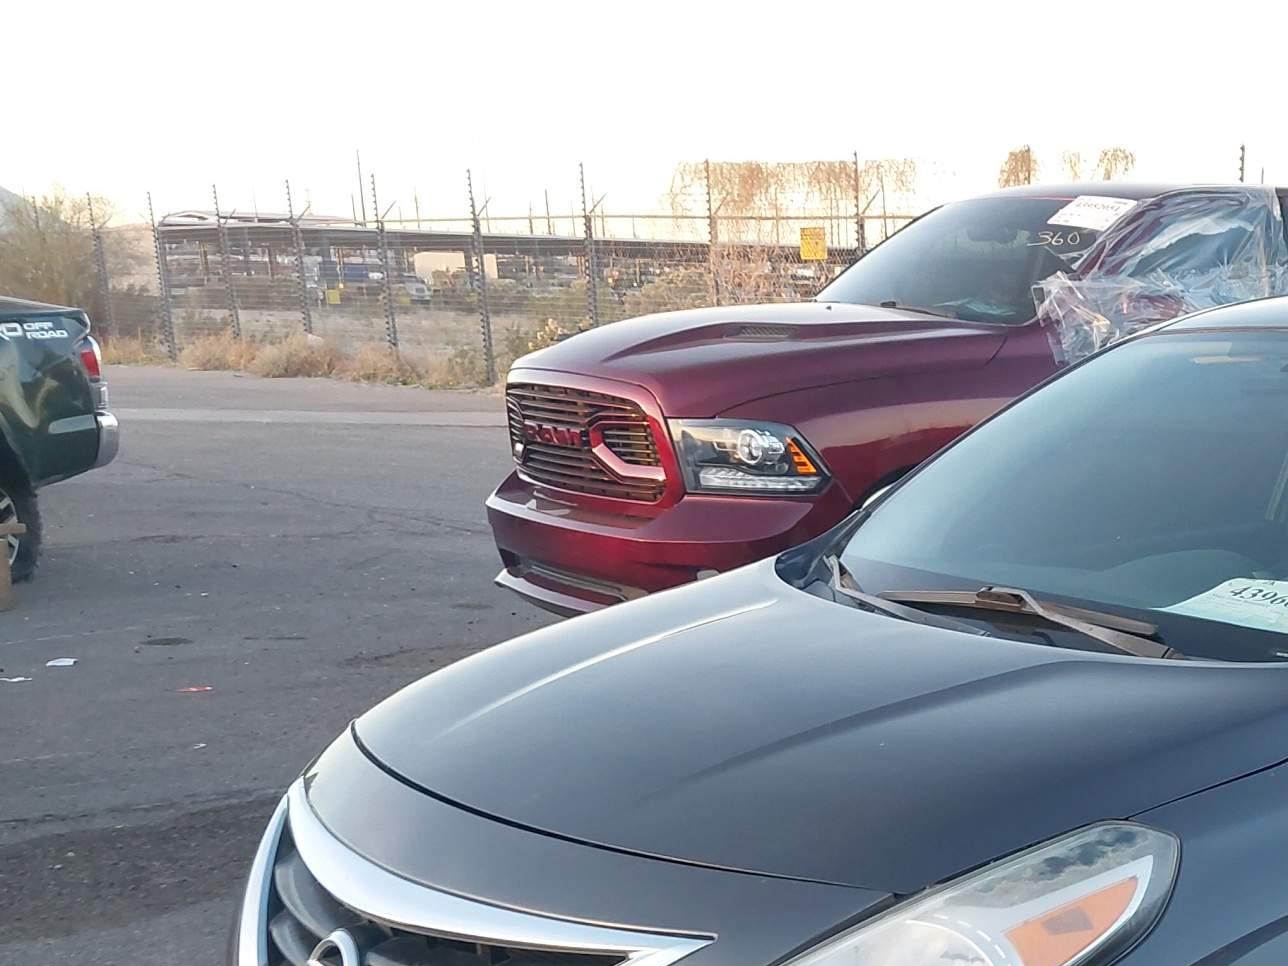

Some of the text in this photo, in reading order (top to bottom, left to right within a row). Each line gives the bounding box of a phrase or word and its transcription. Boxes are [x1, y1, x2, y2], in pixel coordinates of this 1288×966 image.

[1026, 230, 1080, 247] 360
[23, 321, 53, 330] OFF
[25, 329, 69, 340] ROAD
